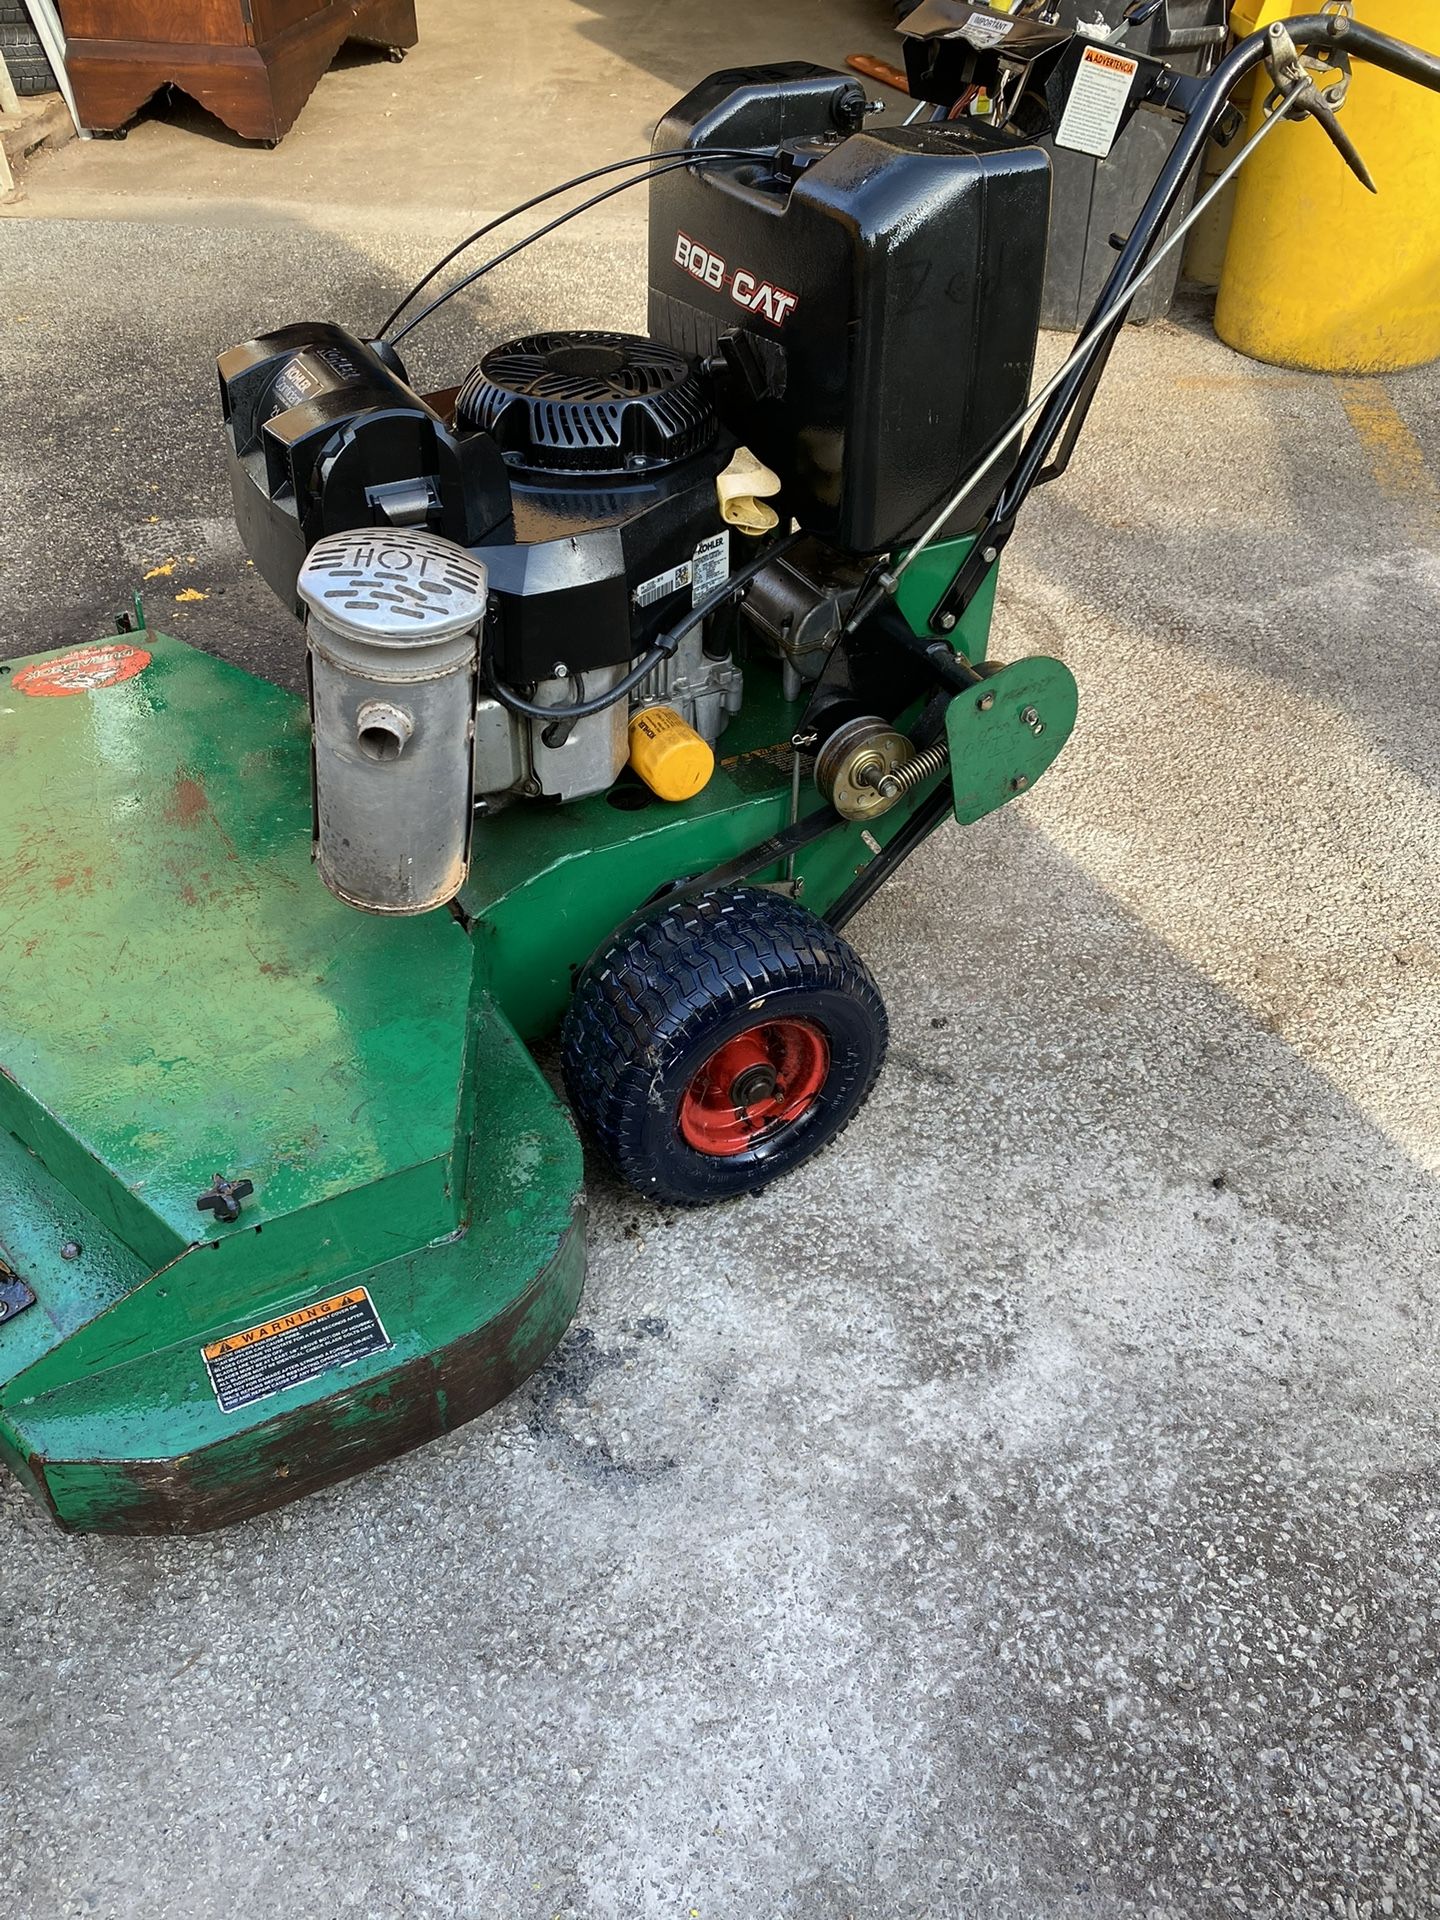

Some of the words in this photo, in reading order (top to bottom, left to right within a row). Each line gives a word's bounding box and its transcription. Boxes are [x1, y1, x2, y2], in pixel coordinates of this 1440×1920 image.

[973, 16, 1008, 30] IMPORTANT
[1093, 53, 1134, 74] ADVERTENCIA
[284, 365, 311, 393] KOHLER
[697, 536, 724, 555] KOHLER
[352, 547, 436, 577] HOT
[241, 1303, 332, 1343] WARNING
